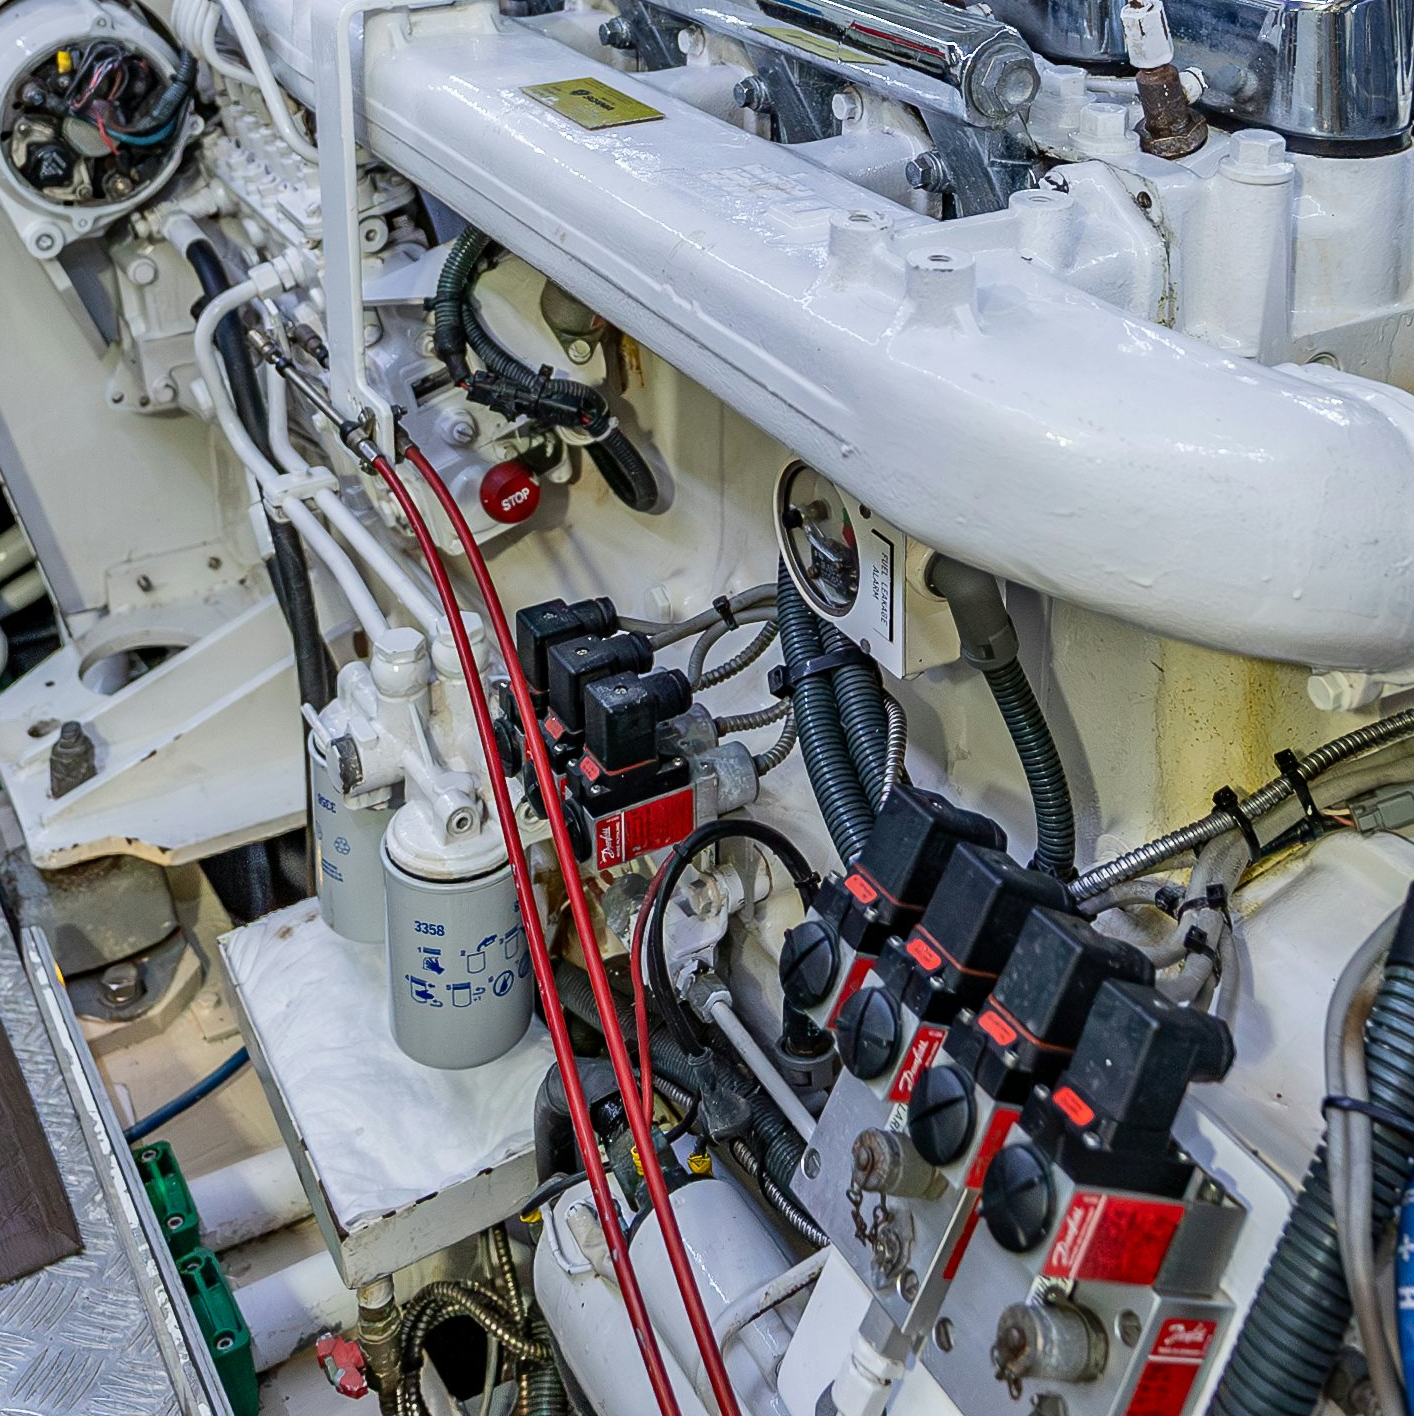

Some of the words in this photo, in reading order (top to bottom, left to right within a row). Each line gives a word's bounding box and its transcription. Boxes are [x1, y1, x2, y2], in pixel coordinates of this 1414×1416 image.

[501, 487, 530, 511] STOP
[880, 551, 889, 577] FUEL
[871, 564, 880, 601] ALARM
[879, 582, 889, 626] LEAKAGE
[414, 920, 445, 937] 3358
